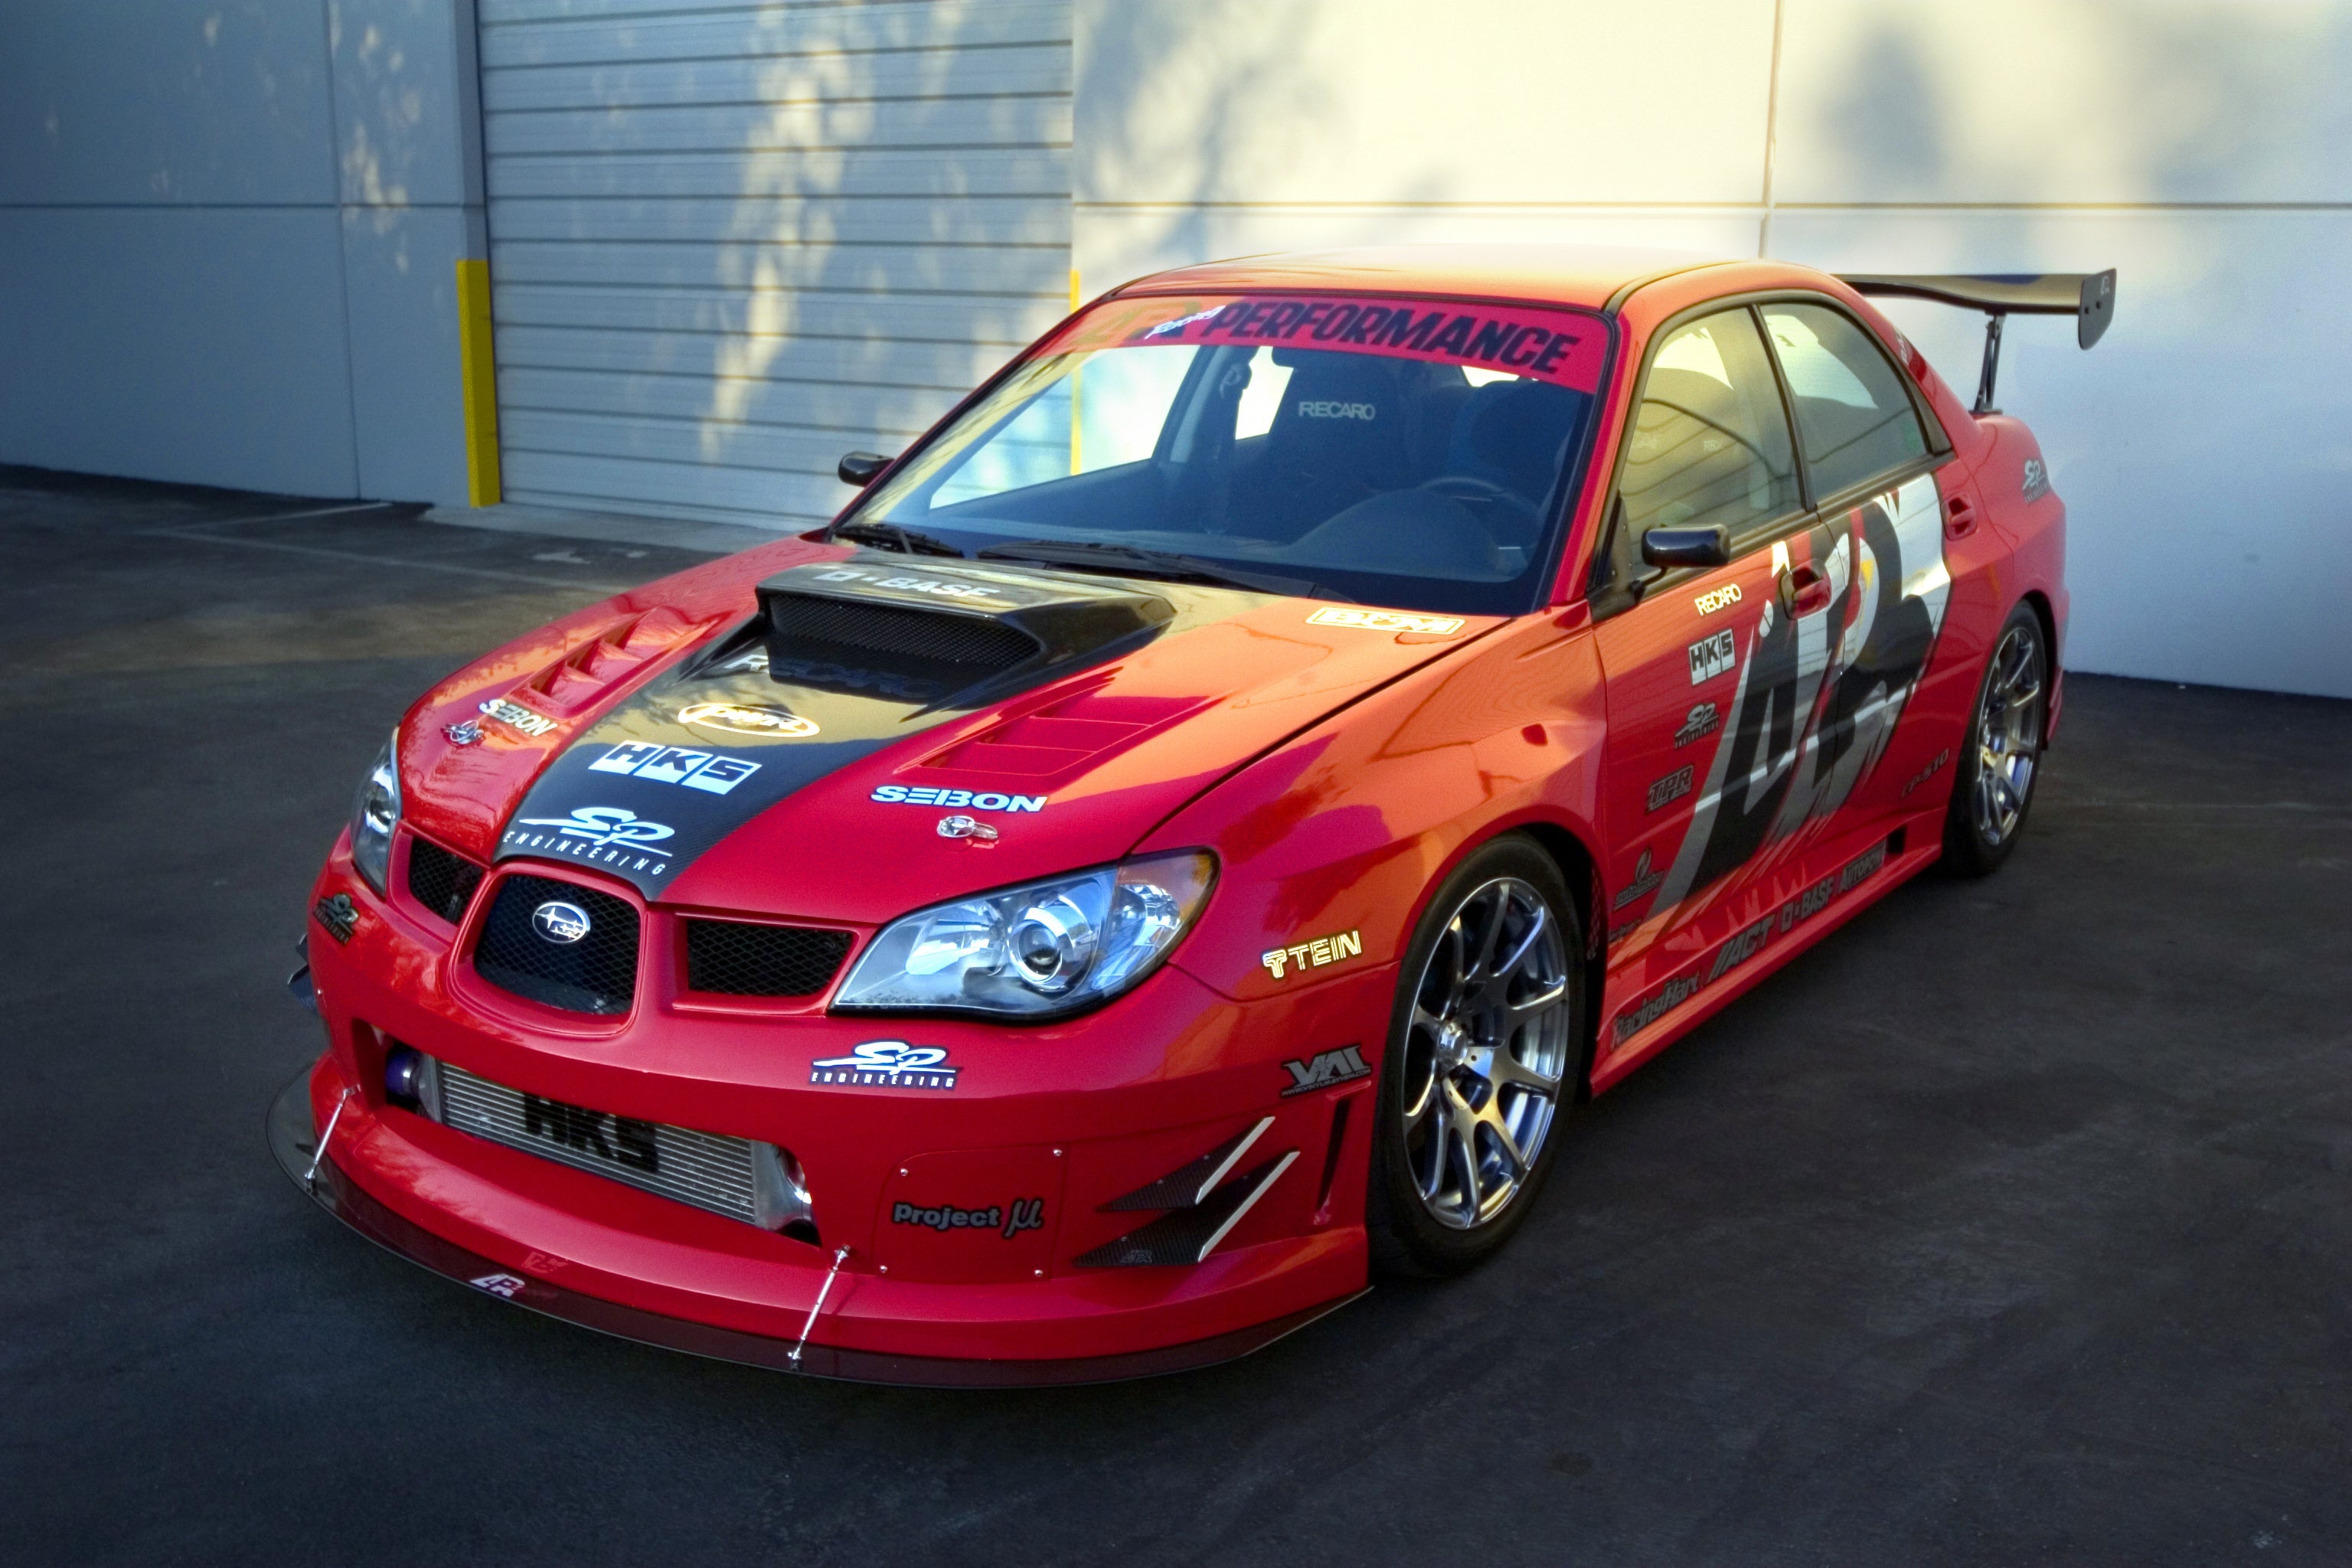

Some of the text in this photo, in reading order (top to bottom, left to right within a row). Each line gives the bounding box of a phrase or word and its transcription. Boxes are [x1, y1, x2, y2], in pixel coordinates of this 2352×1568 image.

[1200, 300, 1579, 374] PERFORMANCE
[1299, 401, 1375, 420] RECARO
[1694, 584, 1742, 616] RECARO
[1689, 629, 1735, 681] HKS
[479, 700, 557, 736] SEIBON
[593, 741, 760, 792] HKS
[1649, 764, 1694, 802] TPR
[871, 786, 1047, 812] SEIBON
[503, 831, 665, 875] ENGINEERING
[1289, 931, 1361, 970] TEIN
[810, 1072, 954, 1087] ENGINEERING
[524, 1091, 659, 1173] HKS
